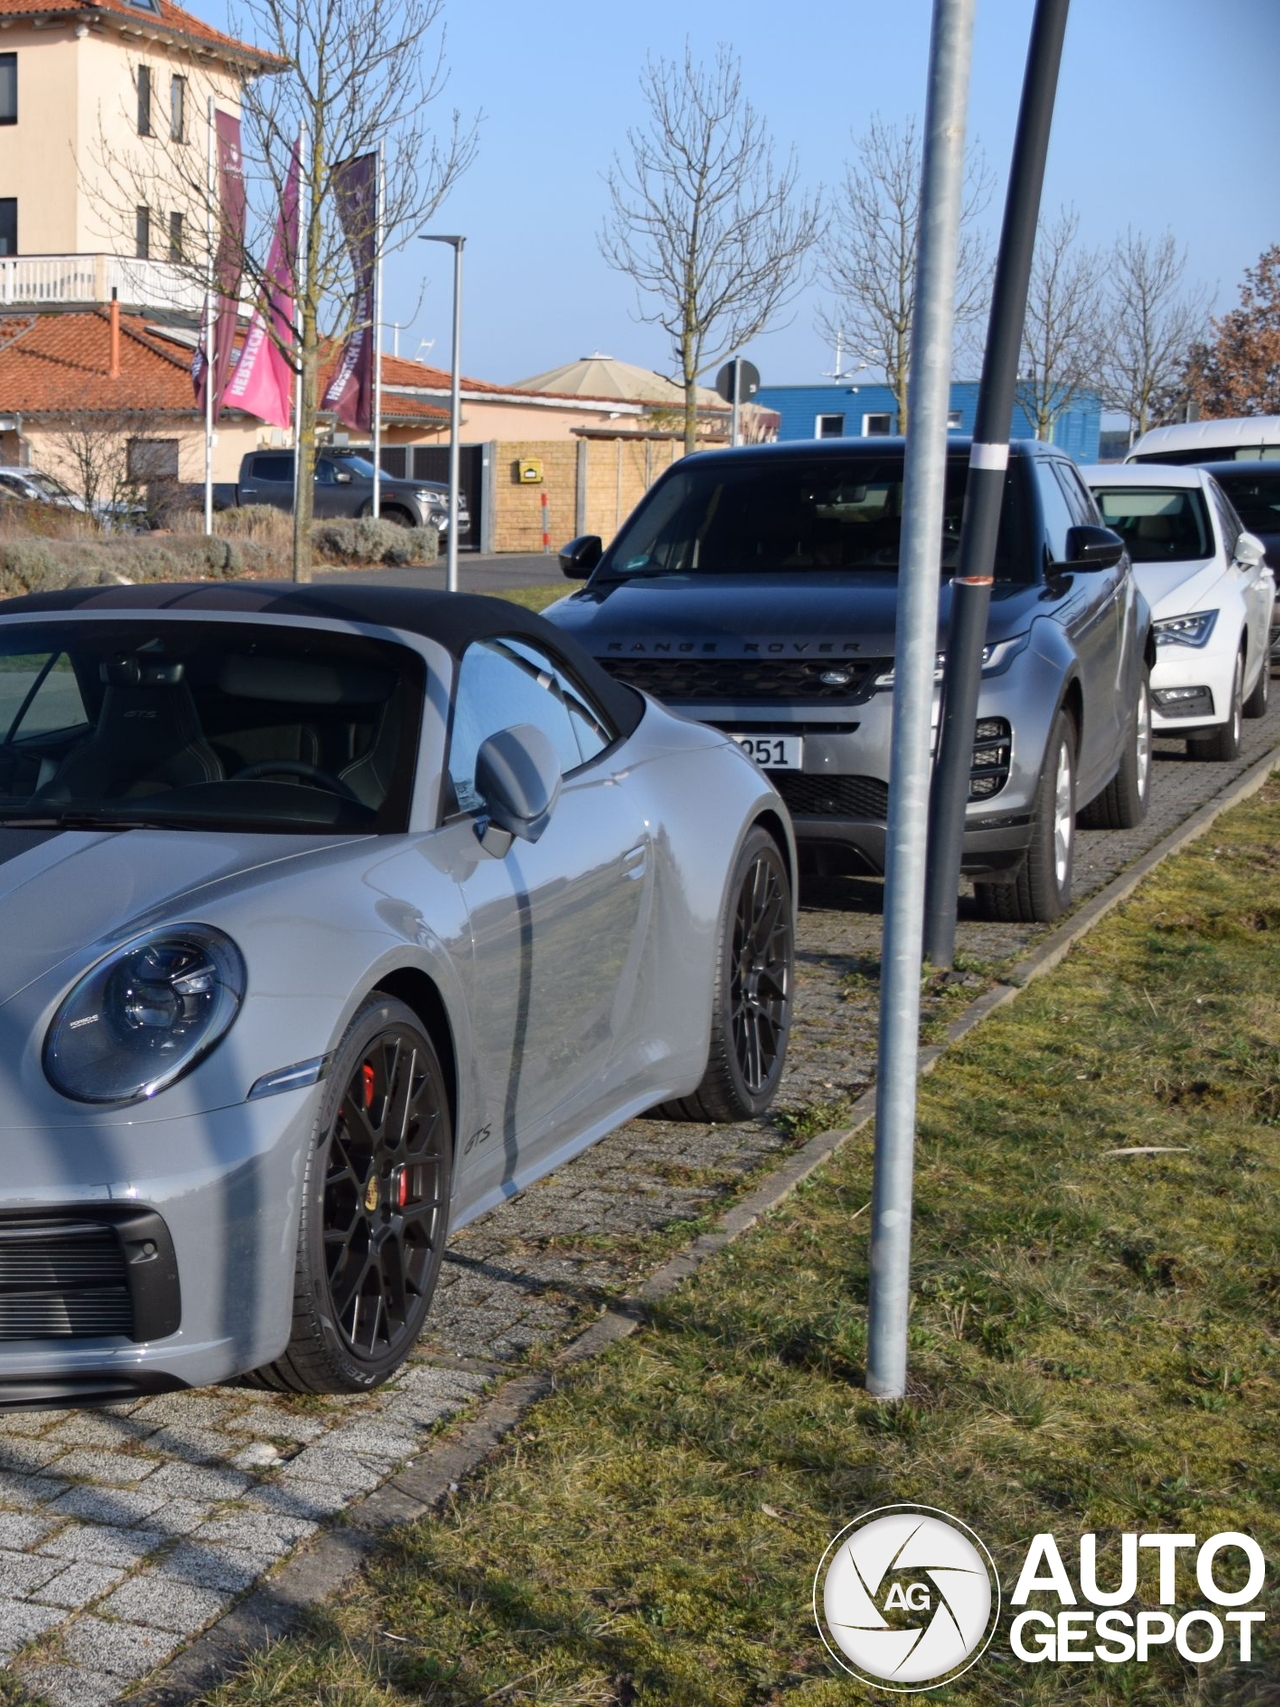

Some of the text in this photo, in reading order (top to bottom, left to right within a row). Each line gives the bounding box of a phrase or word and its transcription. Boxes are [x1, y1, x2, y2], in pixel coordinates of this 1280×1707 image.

[607, 642, 862, 653] RANGE ROVER
[464, 1123, 492, 1155] GTS
